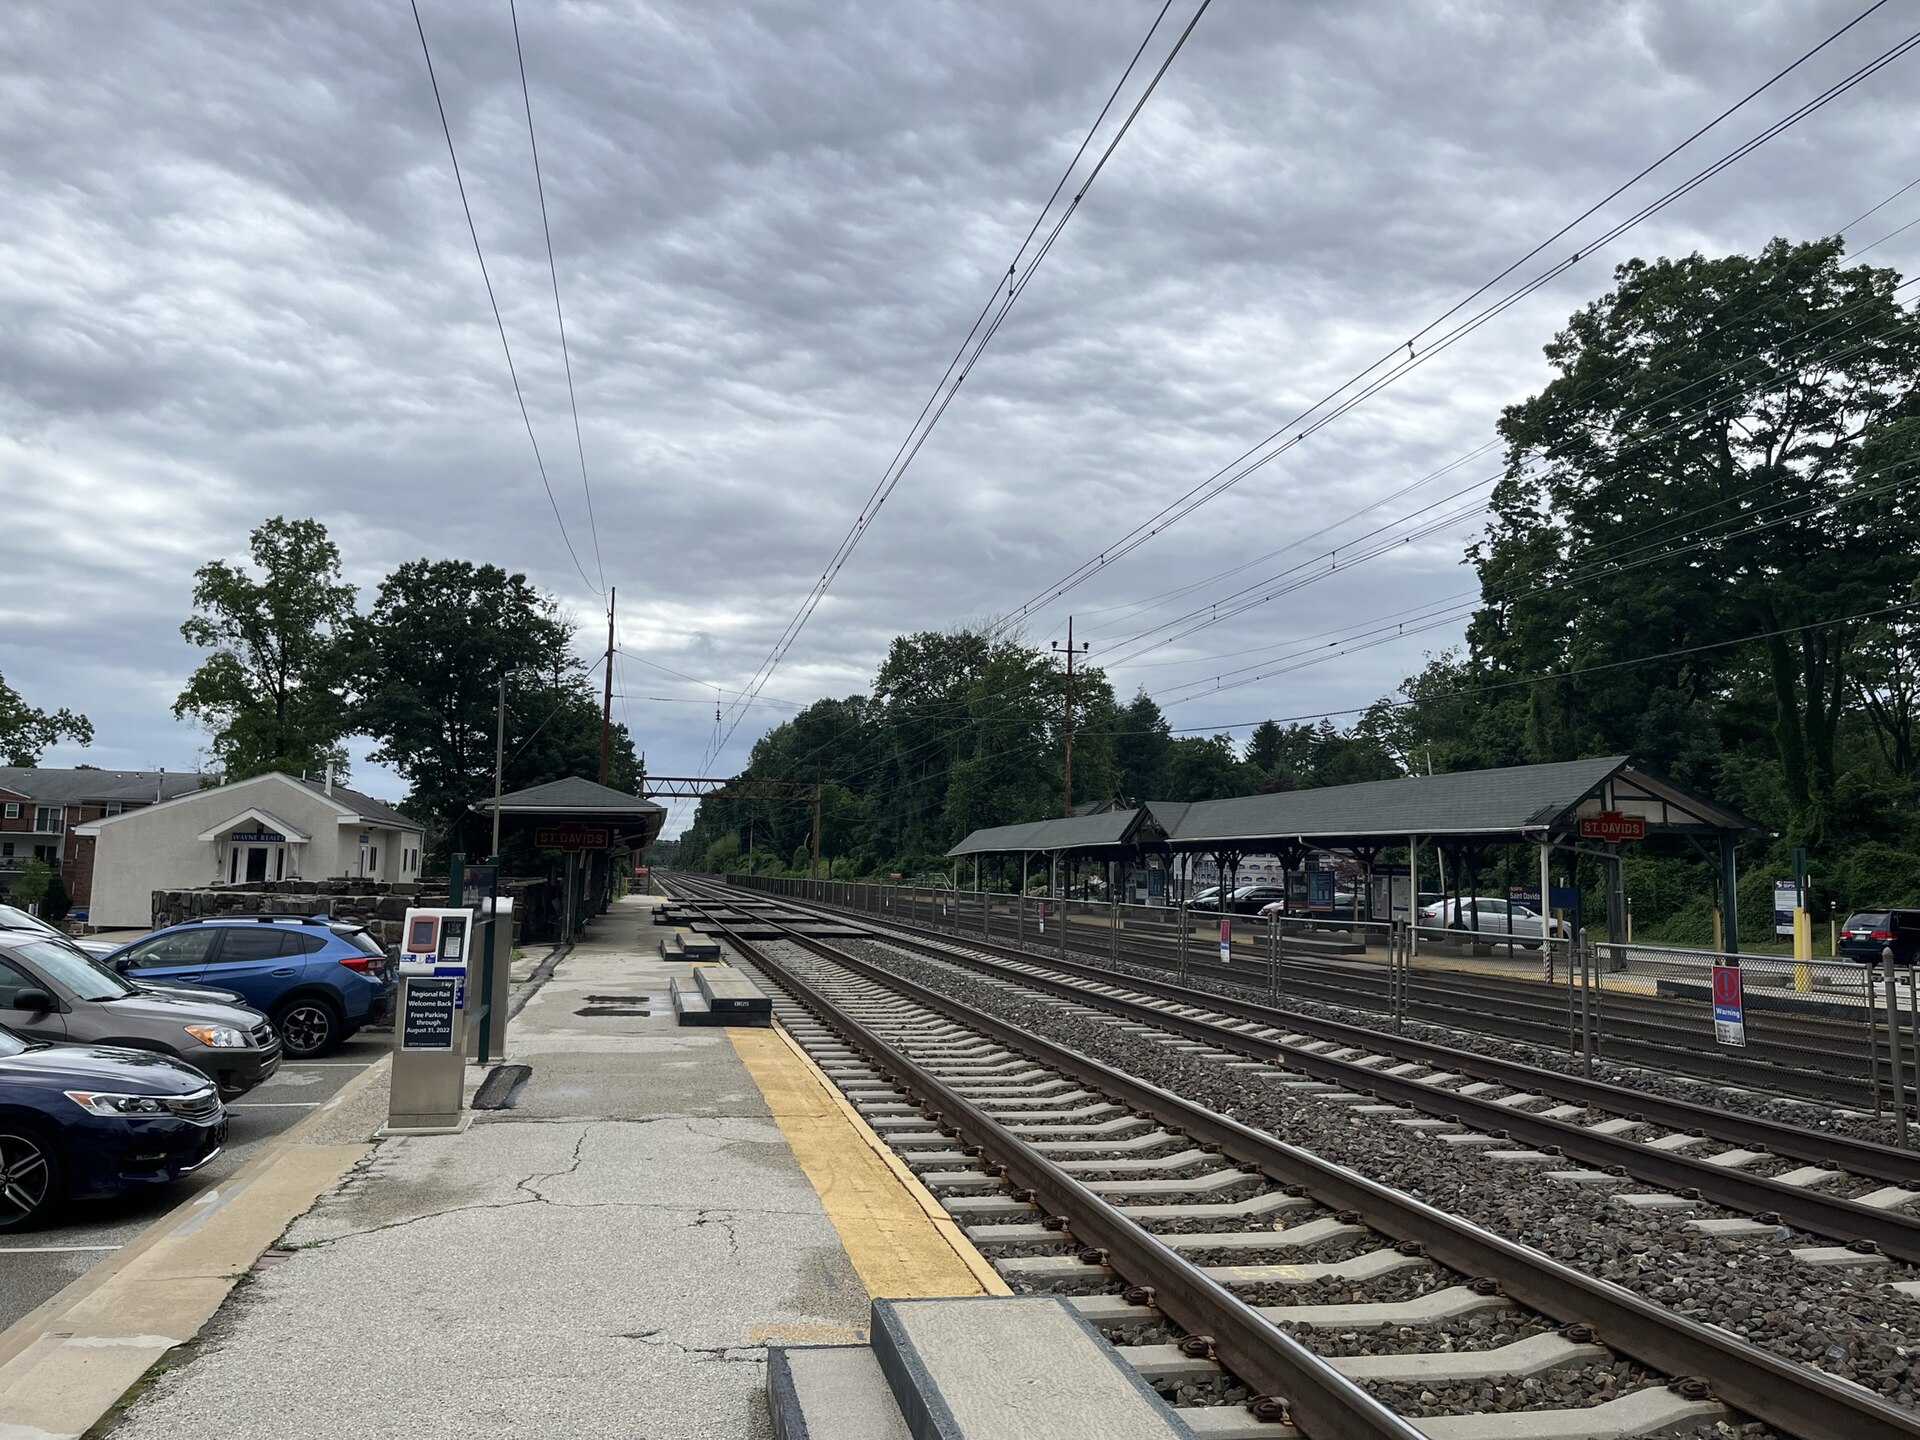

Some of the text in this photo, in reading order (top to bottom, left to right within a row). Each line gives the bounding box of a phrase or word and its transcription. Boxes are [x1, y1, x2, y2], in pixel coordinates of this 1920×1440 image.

[1601, 822, 1640, 834] DAVIDS
[560, 832, 603, 844] DAVIDS
[1509, 892, 1541, 901] Saint Davids
[1716, 1007, 1740, 1019] Warning
